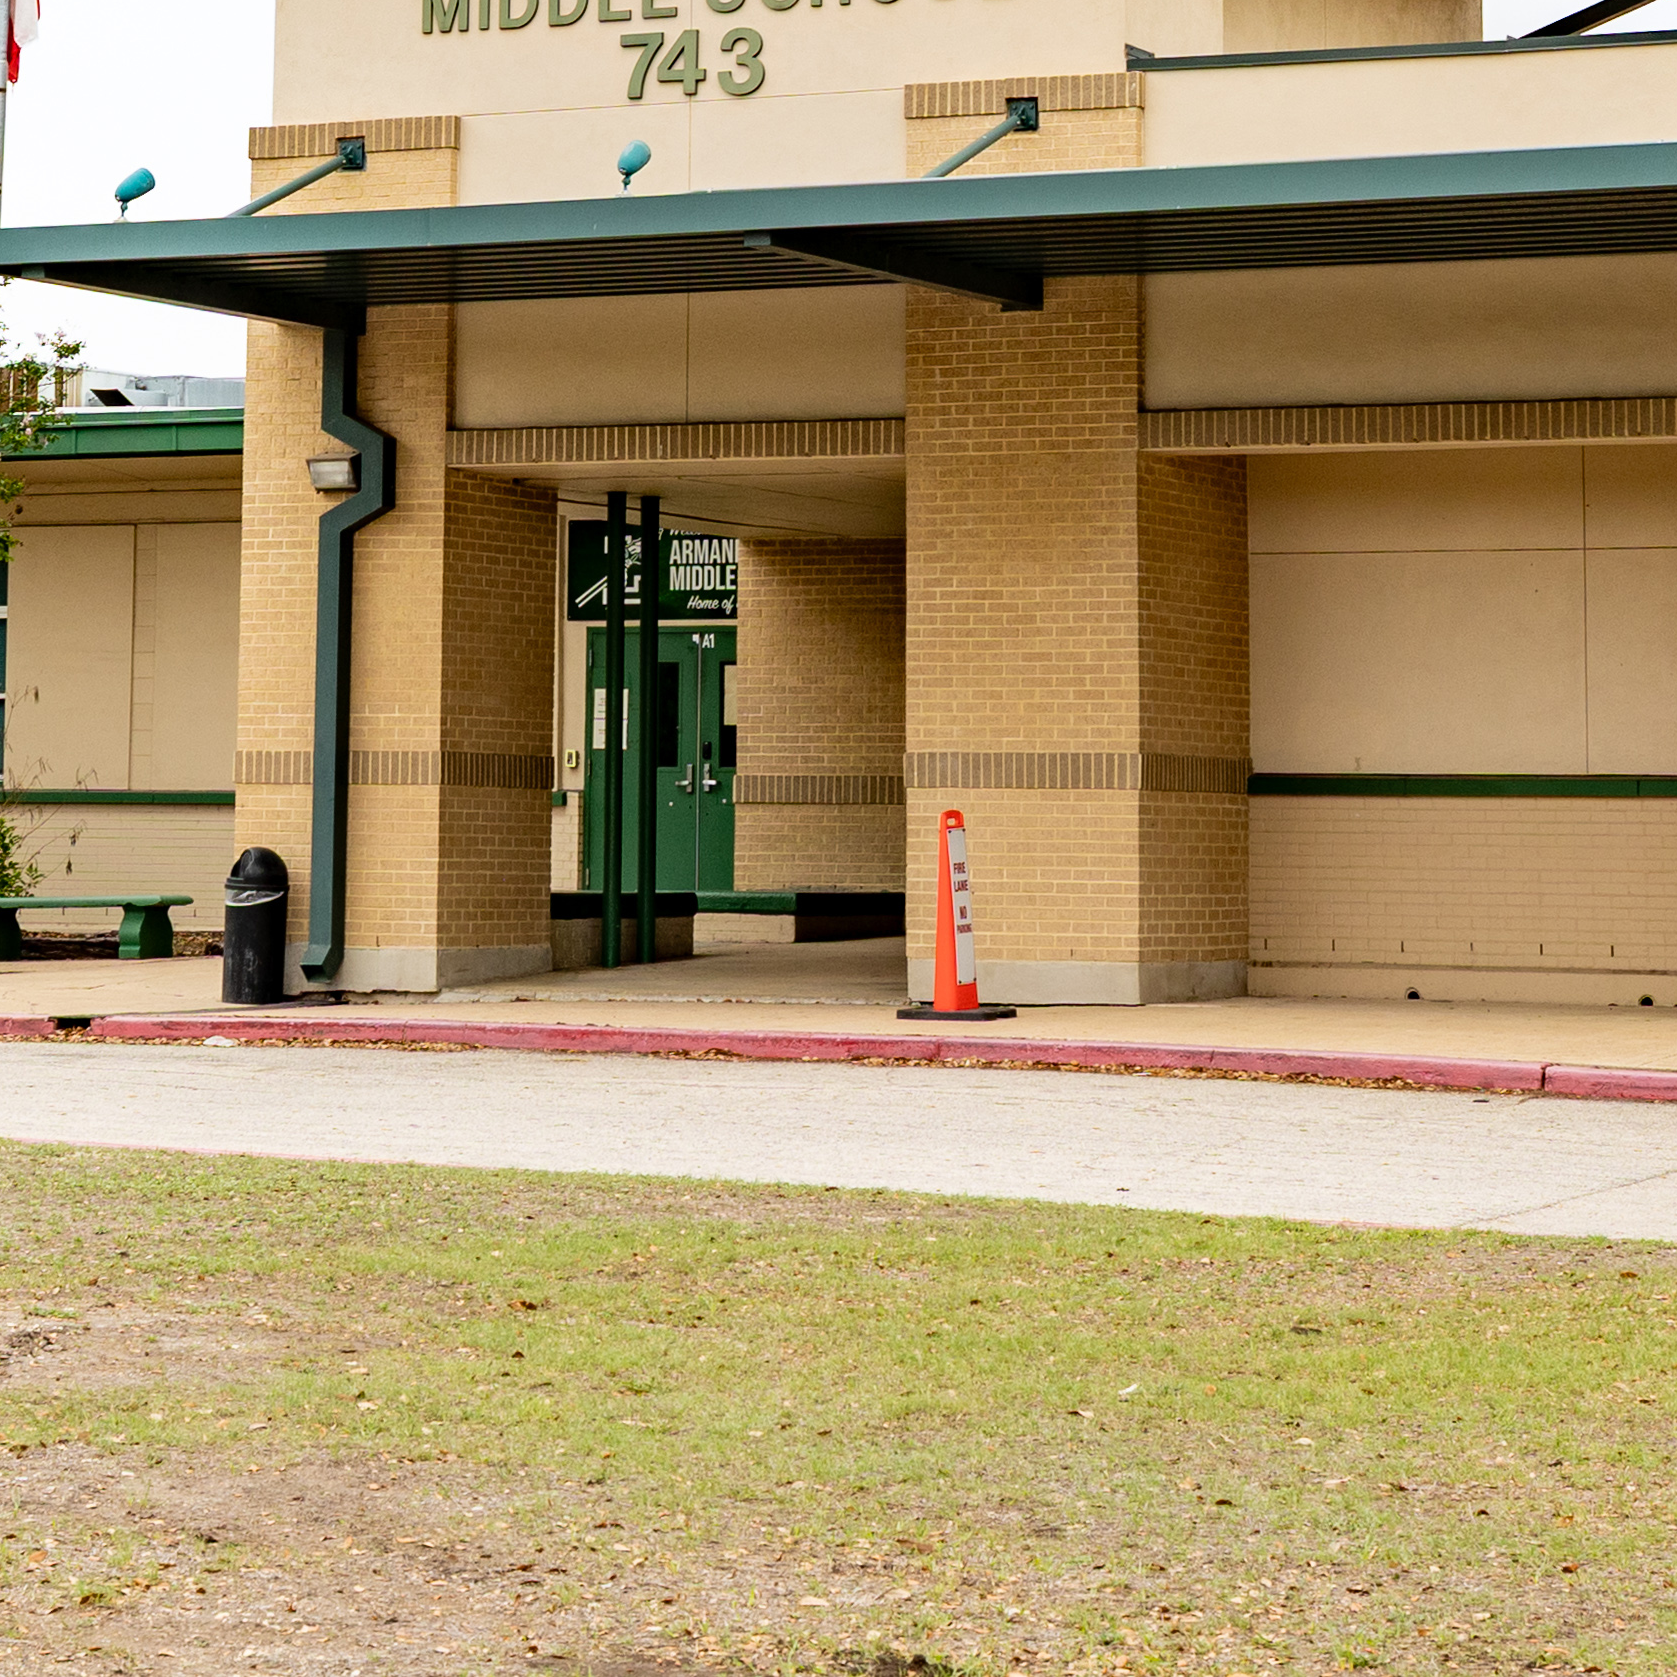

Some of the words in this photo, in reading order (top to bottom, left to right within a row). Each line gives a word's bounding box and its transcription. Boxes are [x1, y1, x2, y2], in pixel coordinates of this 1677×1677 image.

[620, 27, 766, 99] 743
[669, 565, 737, 591] MIDDLE
[686, 595, 720, 610] Home
[722, 594, 735, 615] of
[702, 633, 715, 649] A1
[953, 862, 966, 874] FIRE
[954, 880, 969, 892] LANE
